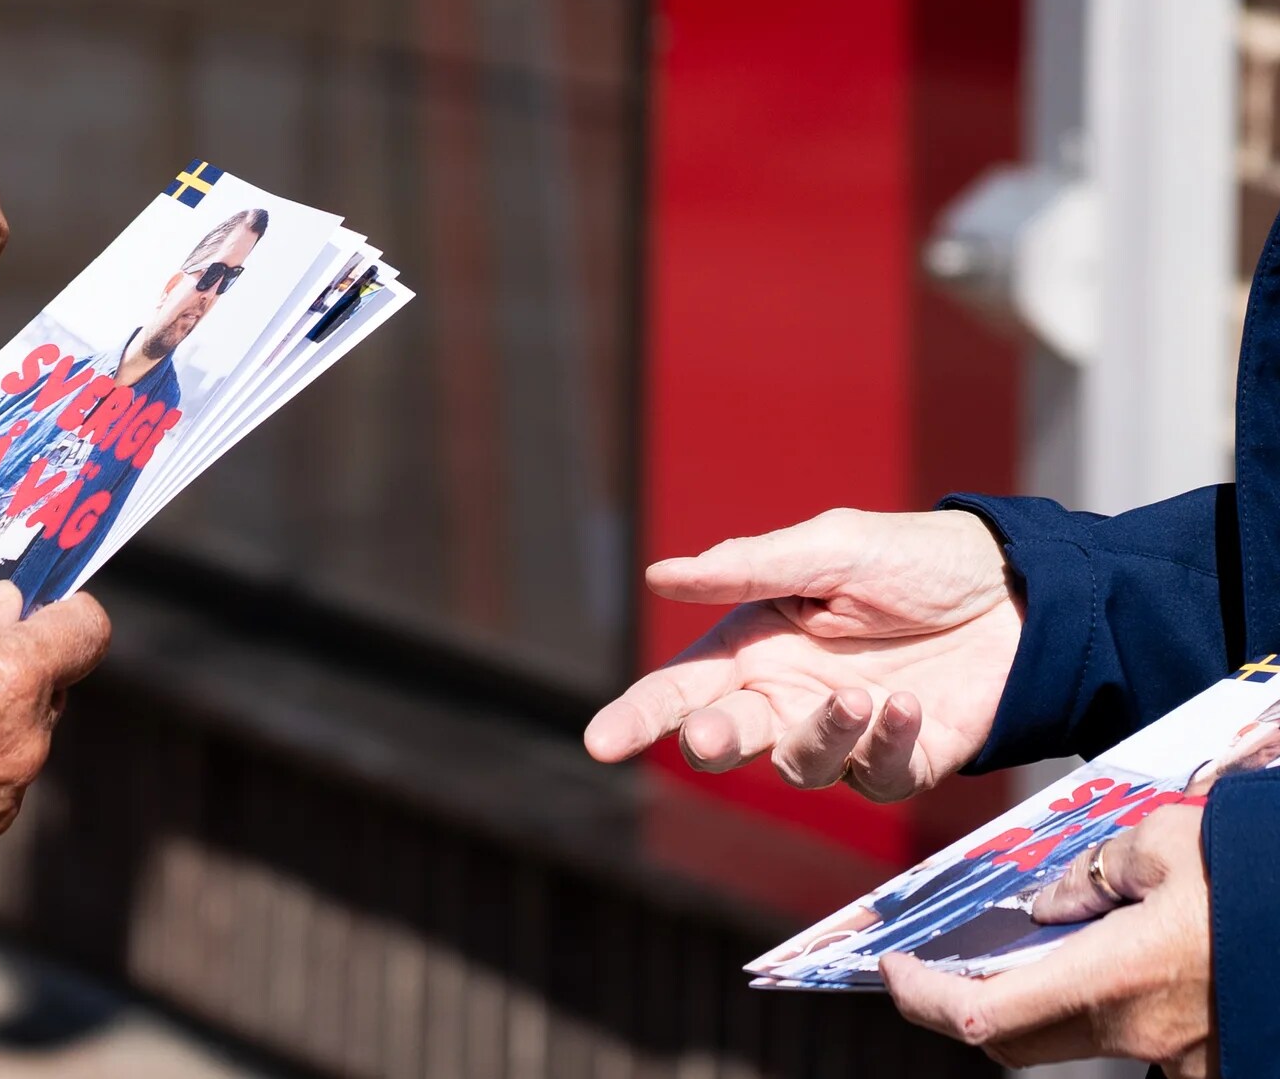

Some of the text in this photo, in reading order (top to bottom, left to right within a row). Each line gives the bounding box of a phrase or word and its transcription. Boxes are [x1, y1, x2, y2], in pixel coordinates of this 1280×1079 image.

[1, 344, 182, 469] SVERIGE
[5, 458, 112, 550] VÄG
[1049, 778, 1208, 827] SVE
[964, 825, 1083, 873] PÅ
